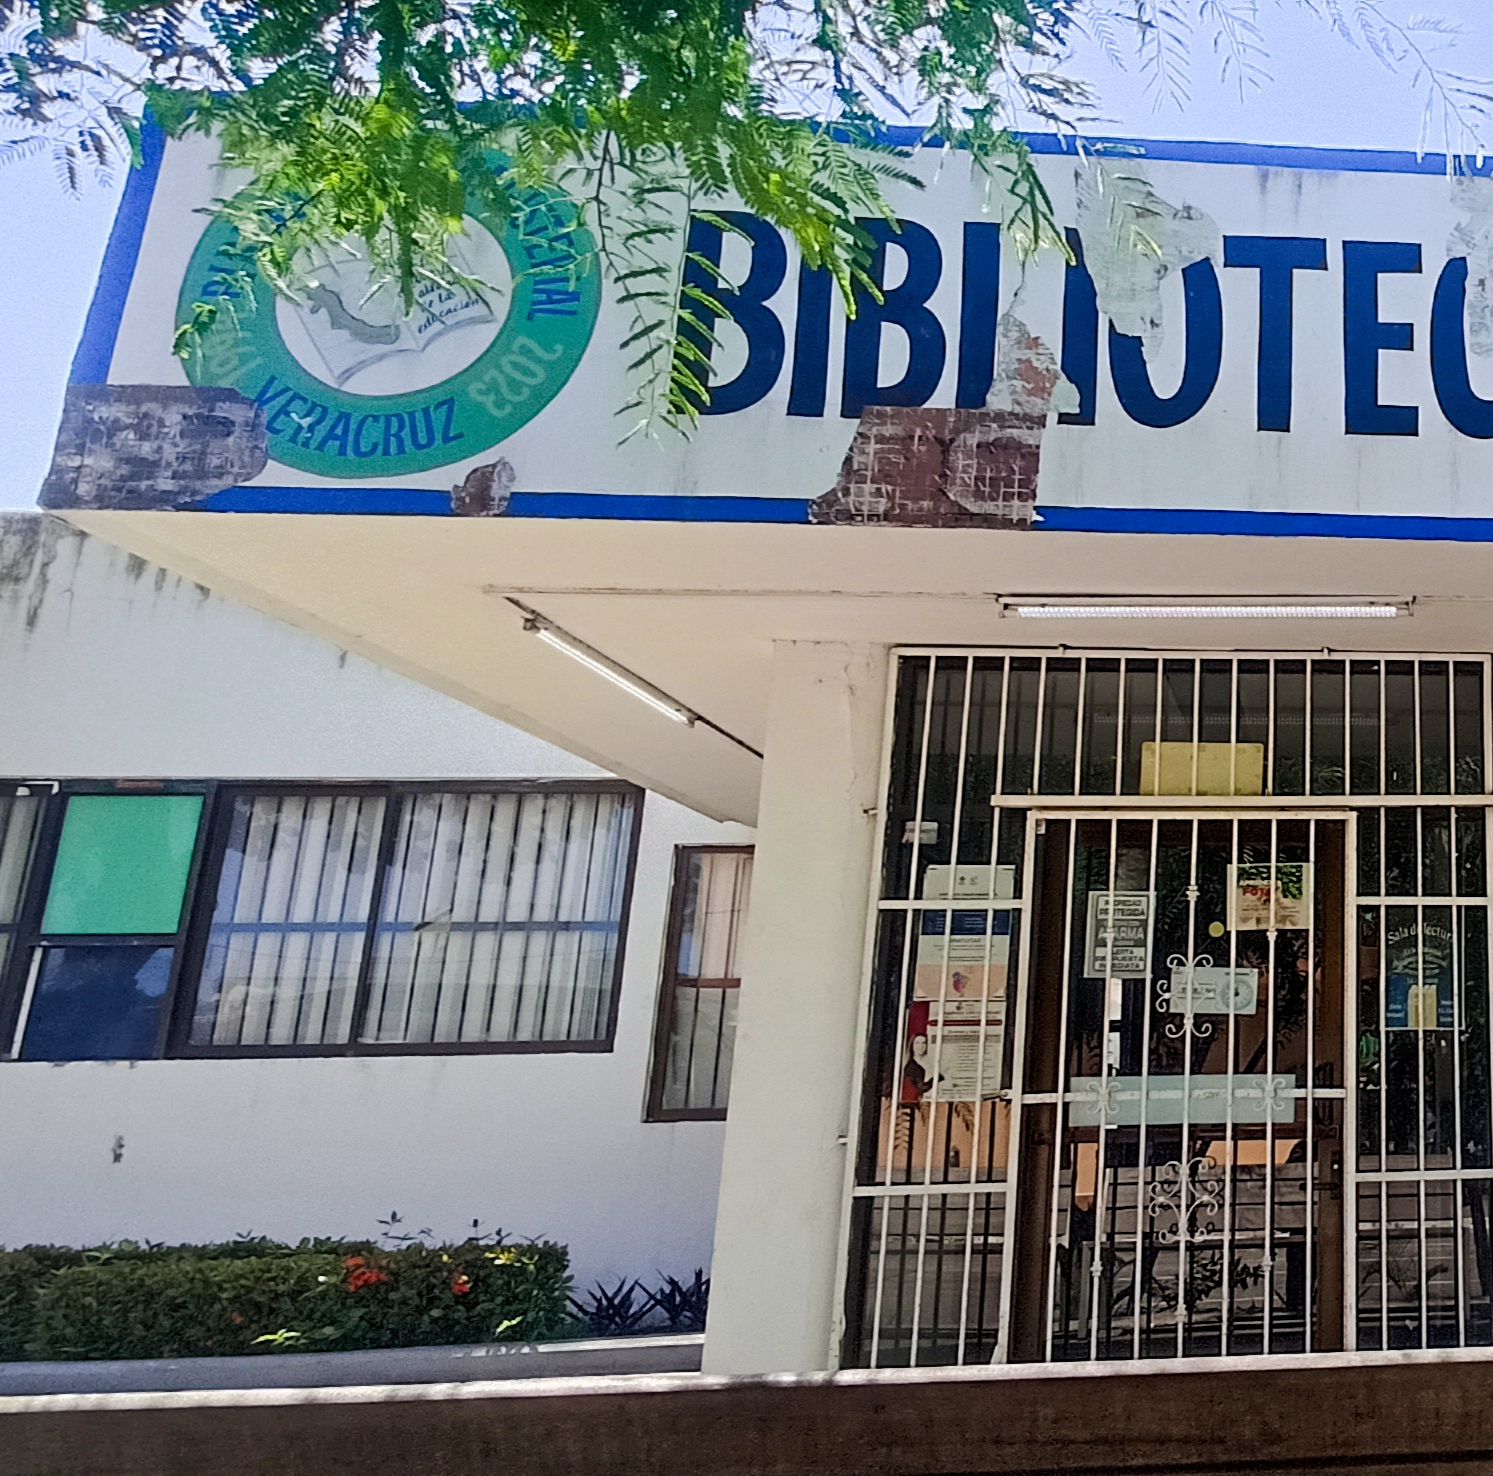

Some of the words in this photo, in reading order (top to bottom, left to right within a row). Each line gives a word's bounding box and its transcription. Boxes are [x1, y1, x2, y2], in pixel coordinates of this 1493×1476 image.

[466, 335, 565, 419] 2023
[254, 374, 464, 458] VERACRUZ
[1099, 908, 1146, 917] PRTEGIDA
[1097, 926, 1145, 940] AARMA
[1387, 926, 1409, 945] Sala
[1422, 922, 1455, 943] lectur
